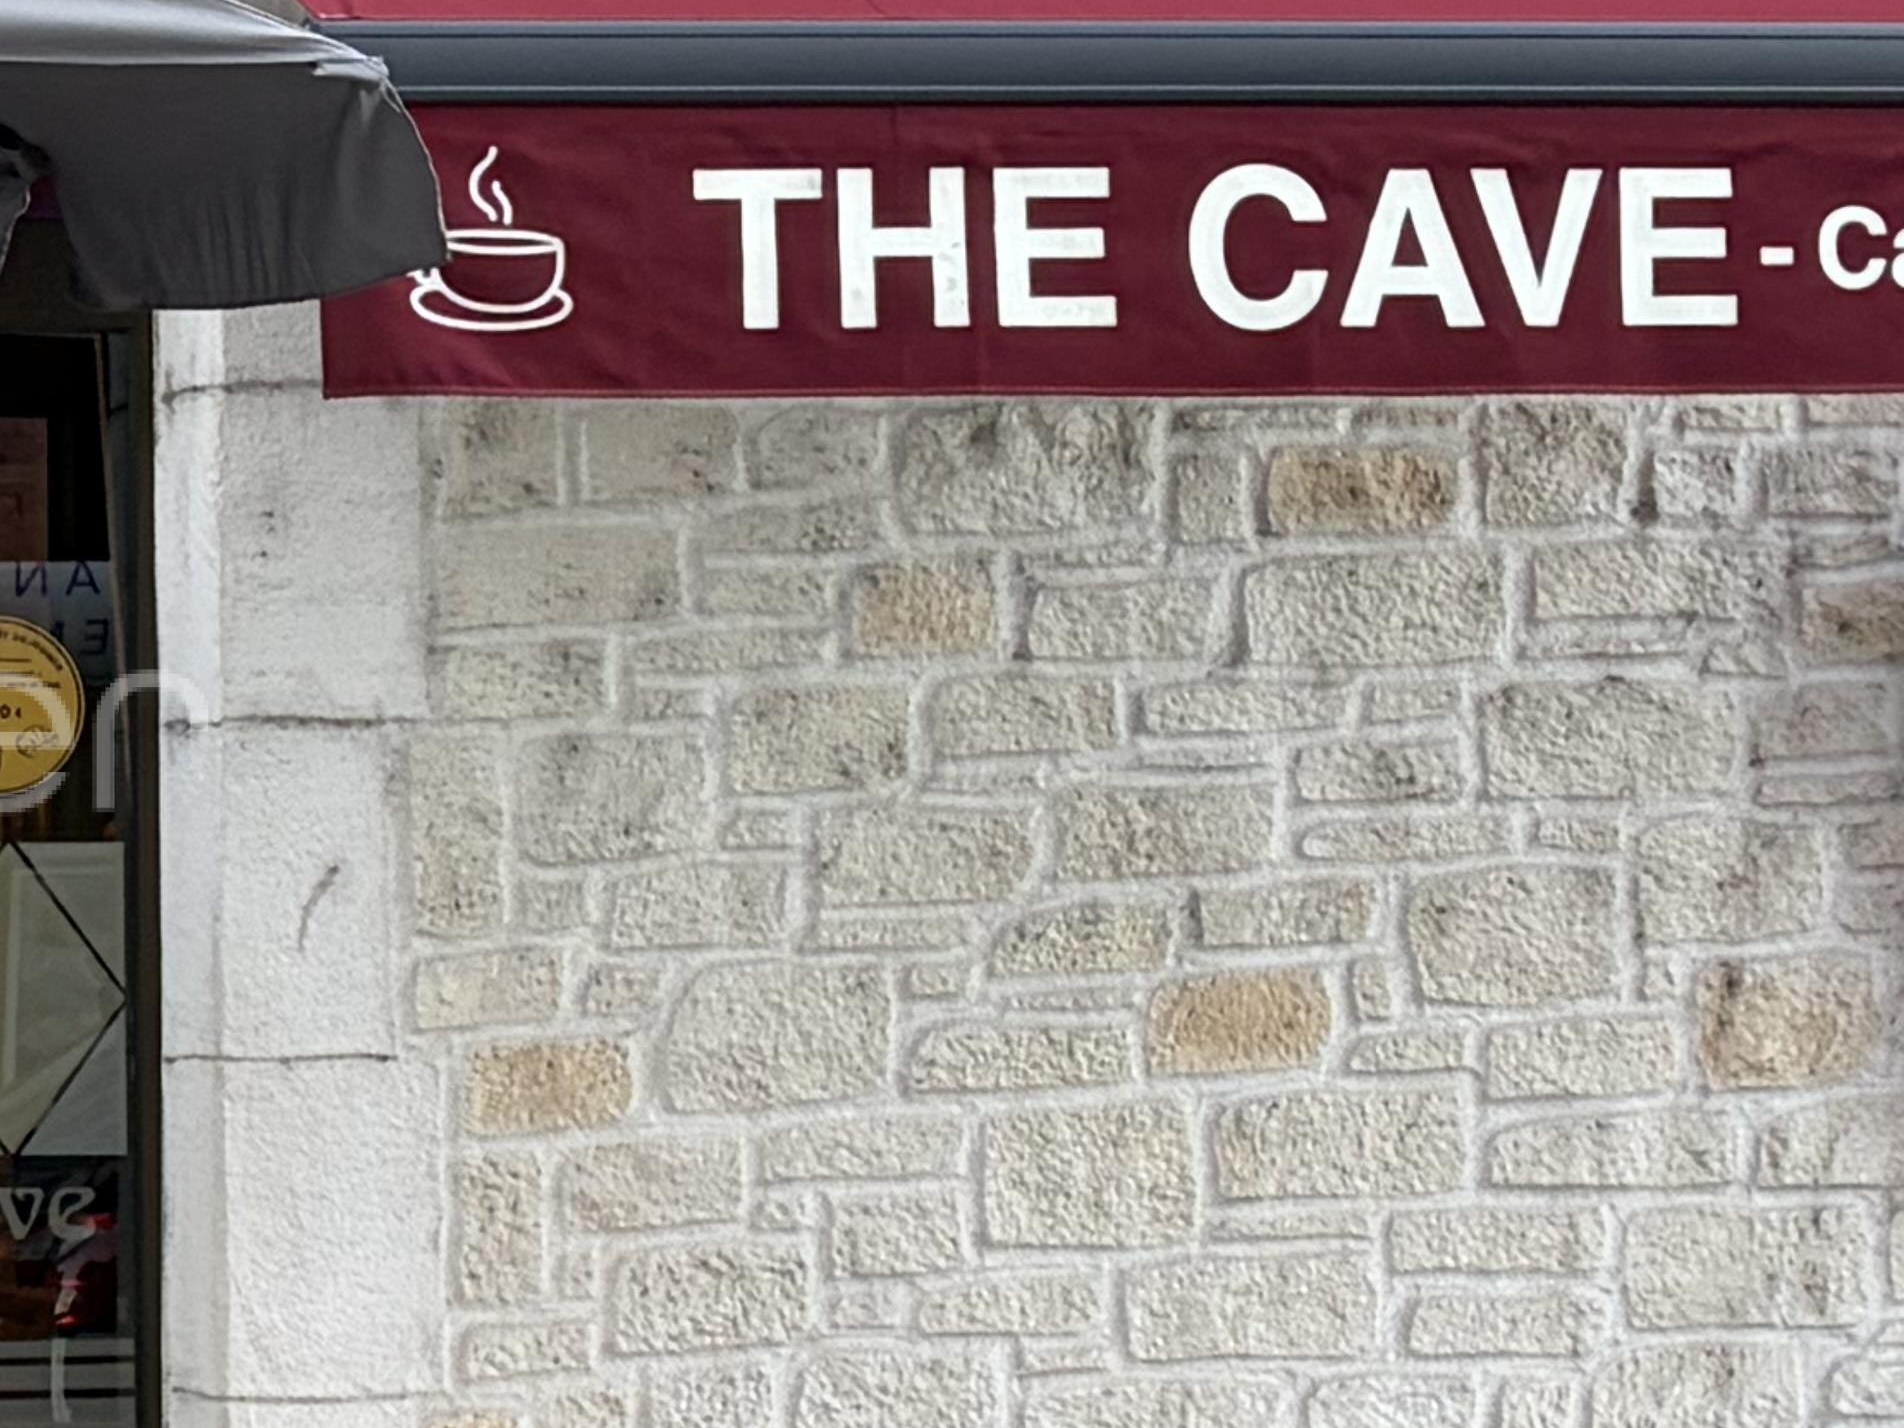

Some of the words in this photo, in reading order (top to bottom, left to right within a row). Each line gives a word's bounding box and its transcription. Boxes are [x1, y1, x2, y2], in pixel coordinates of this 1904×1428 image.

[690, 164, 1118, 331] THE
[1186, 162, 1740, 332] CAVE
[1818, 204, 1904, 292] C
